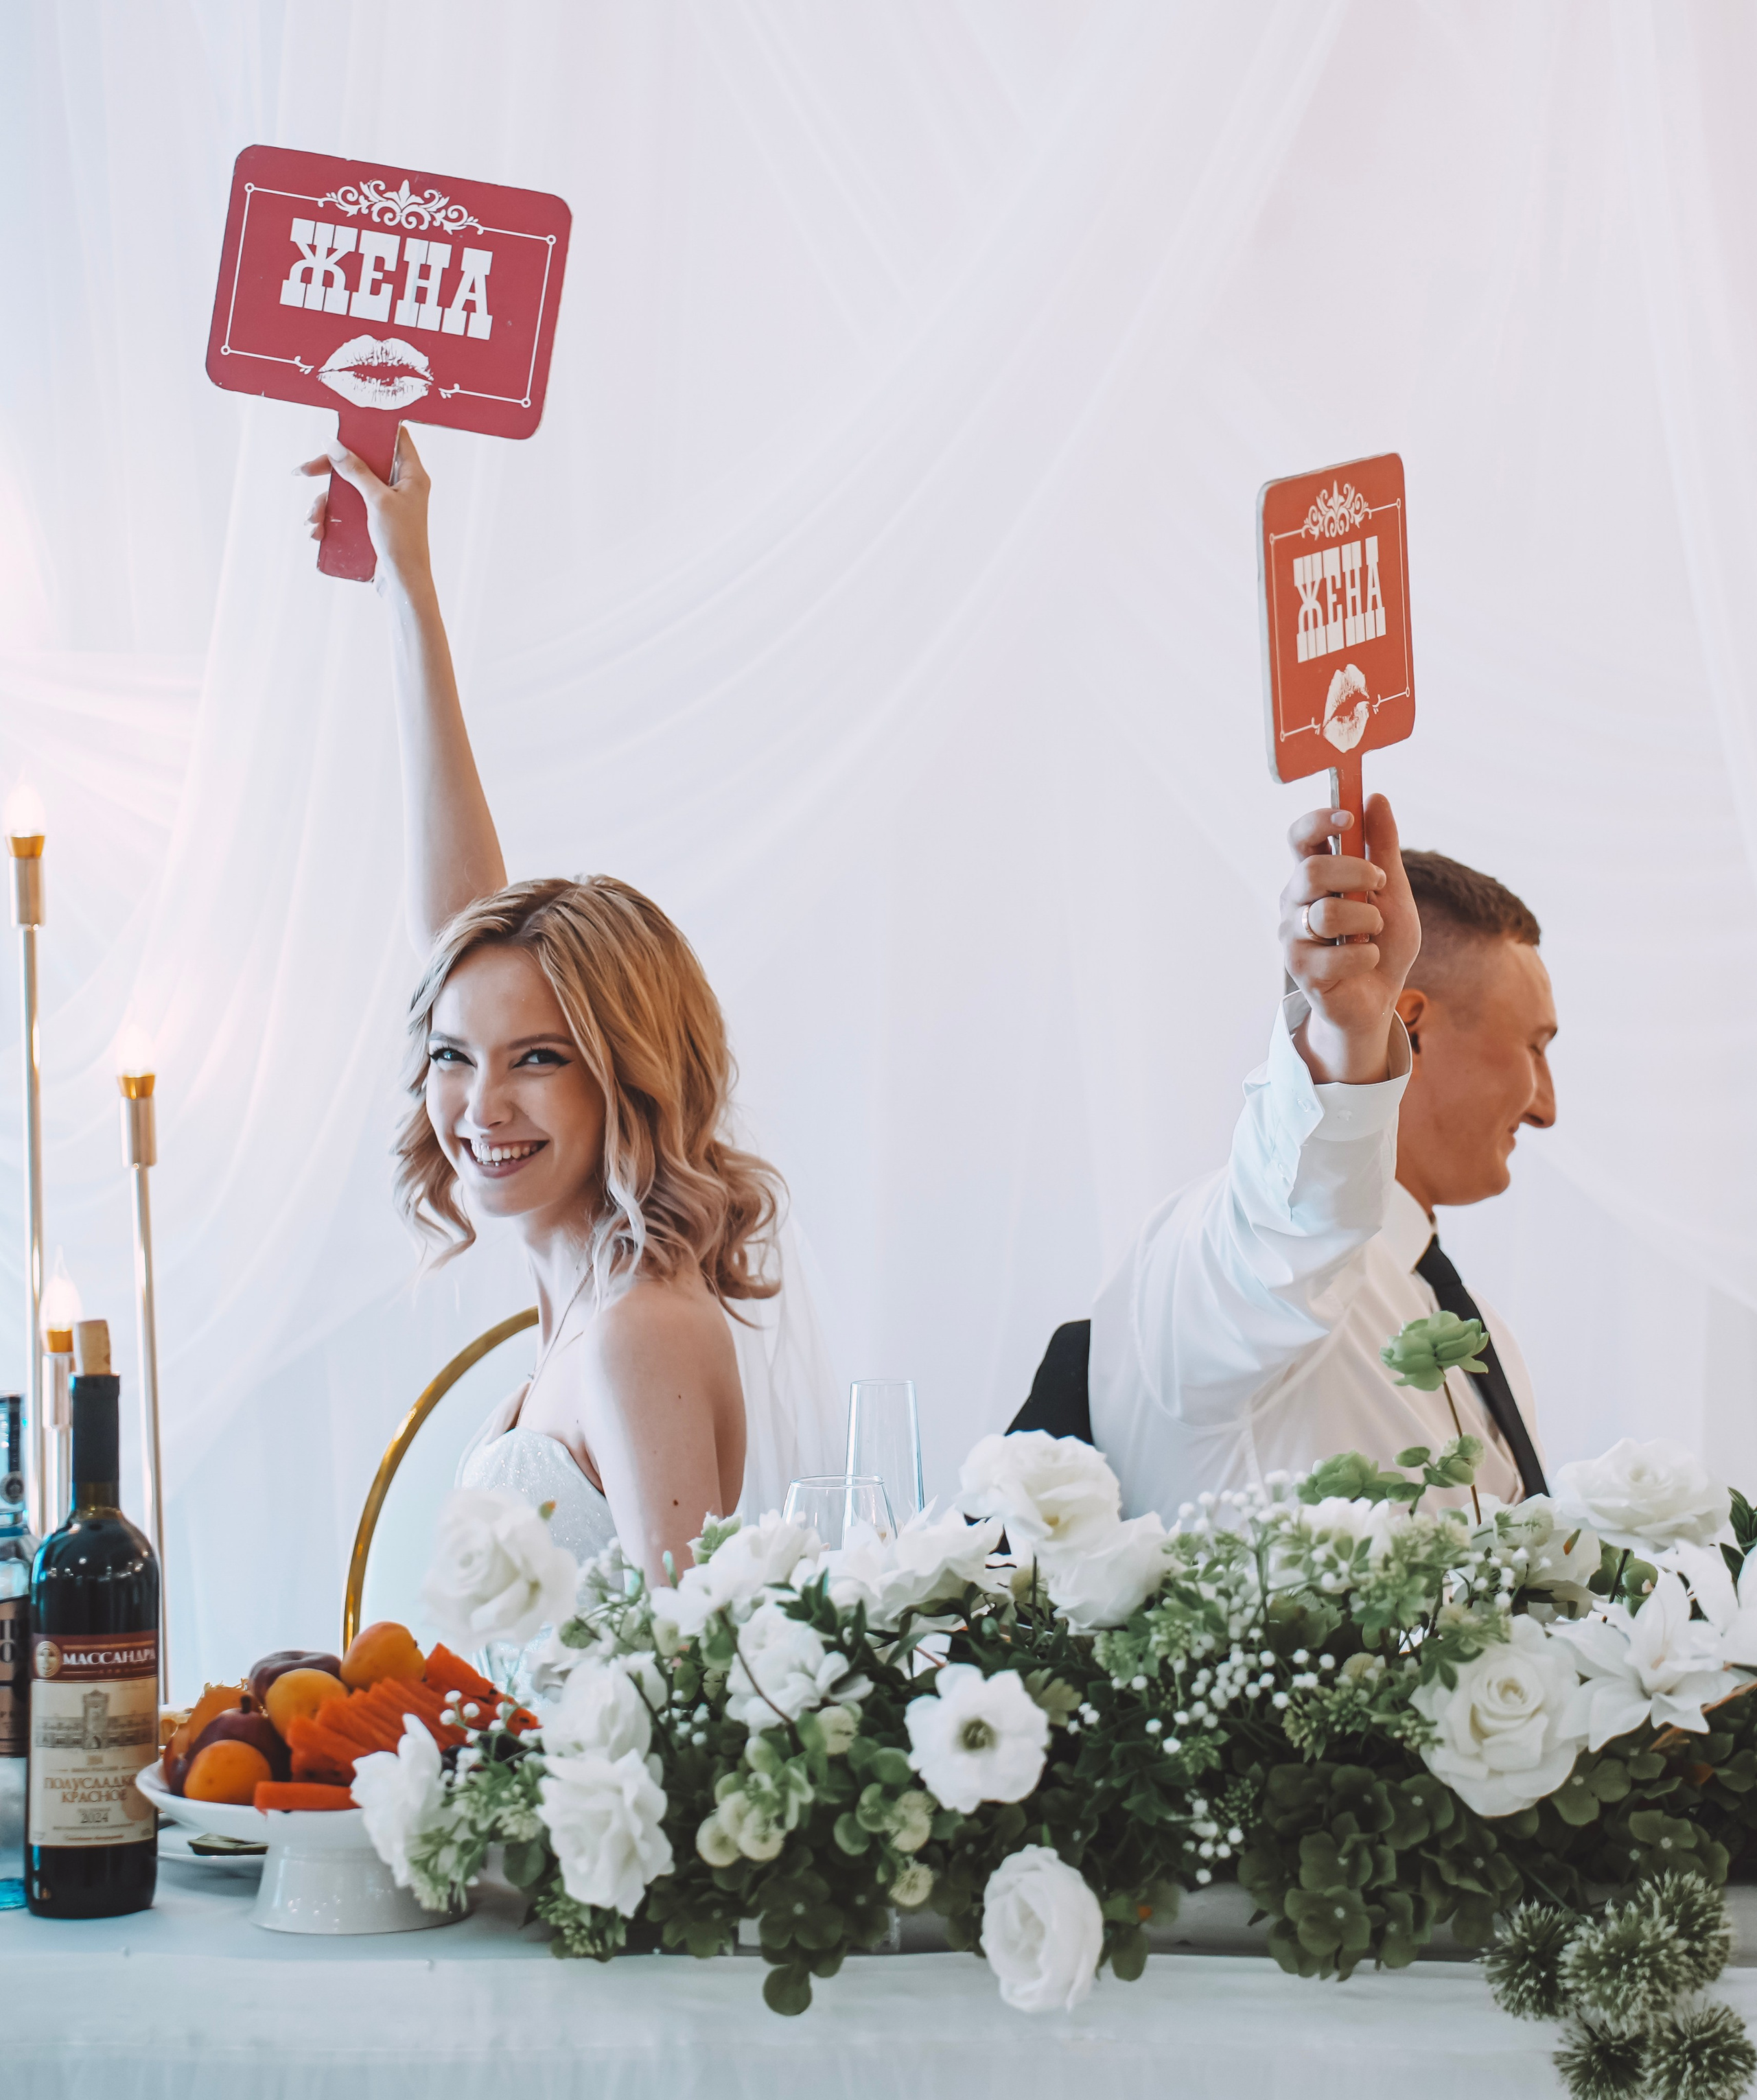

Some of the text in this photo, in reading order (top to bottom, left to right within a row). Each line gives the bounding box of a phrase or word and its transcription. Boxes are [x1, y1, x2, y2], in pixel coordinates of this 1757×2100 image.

[279, 218, 493, 340] ЖЕНА
[1293, 535, 1386, 663] ЖЕНА
[43, 1774, 137, 1790] ПОЛУСЛАДКО
[61, 1788, 128, 1803] КРАСНОЕ
